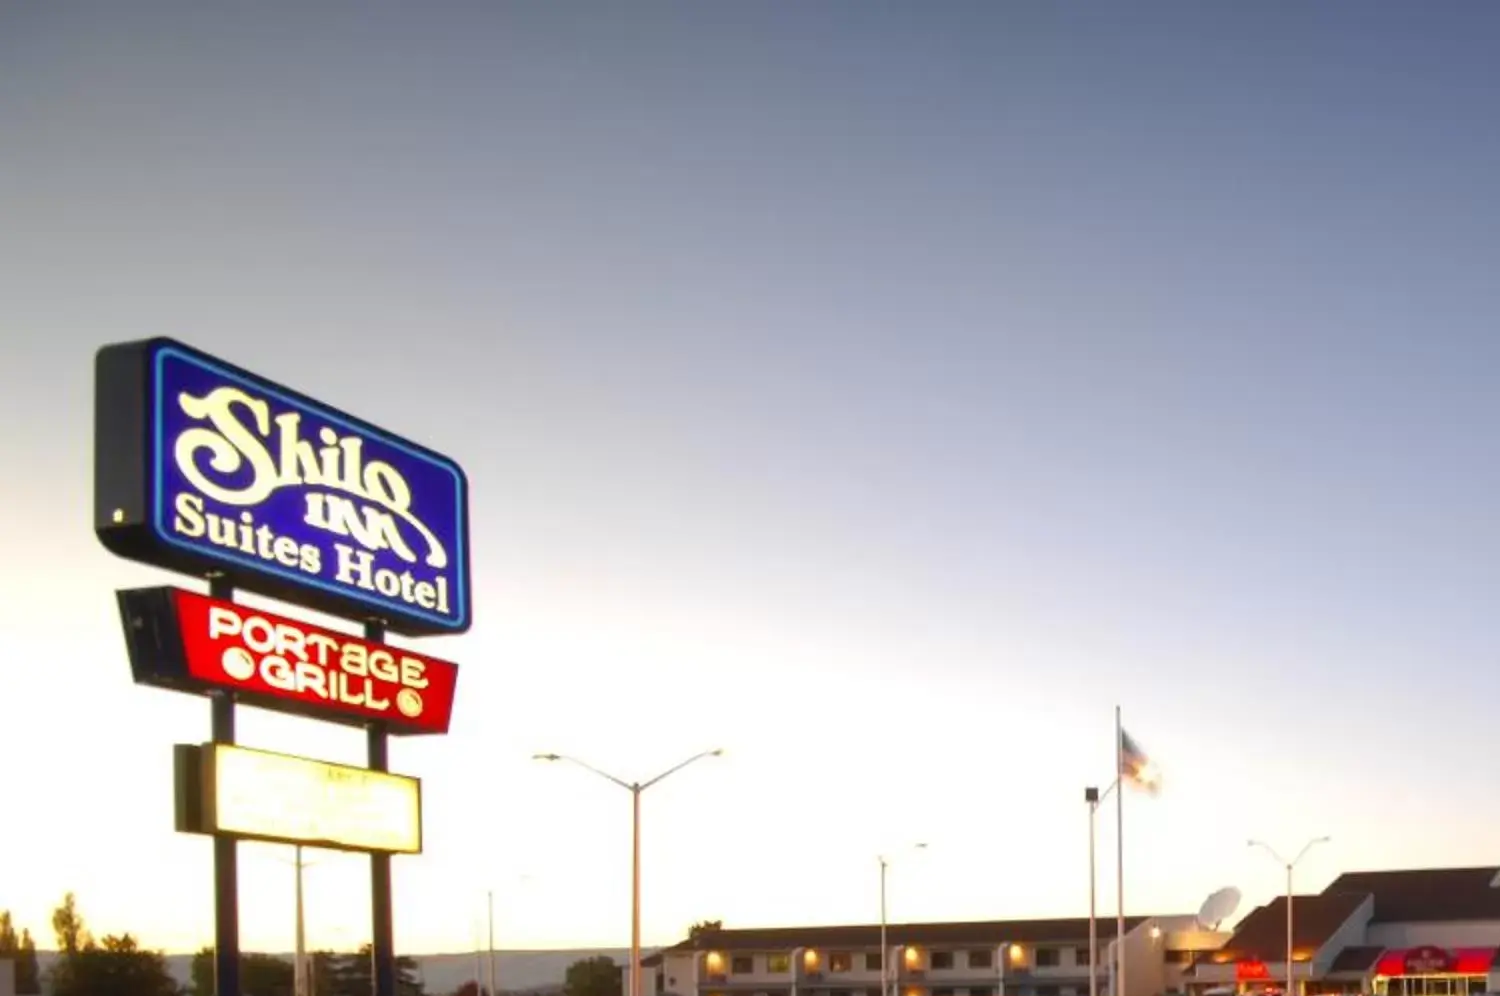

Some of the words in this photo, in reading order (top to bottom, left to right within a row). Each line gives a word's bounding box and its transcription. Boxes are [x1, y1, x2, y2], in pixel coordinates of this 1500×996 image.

[175, 386, 413, 520] Shilo
[175, 492, 321, 575] Suites
[335, 543, 450, 614] Hotel
[259, 655, 390, 711] GRILL
